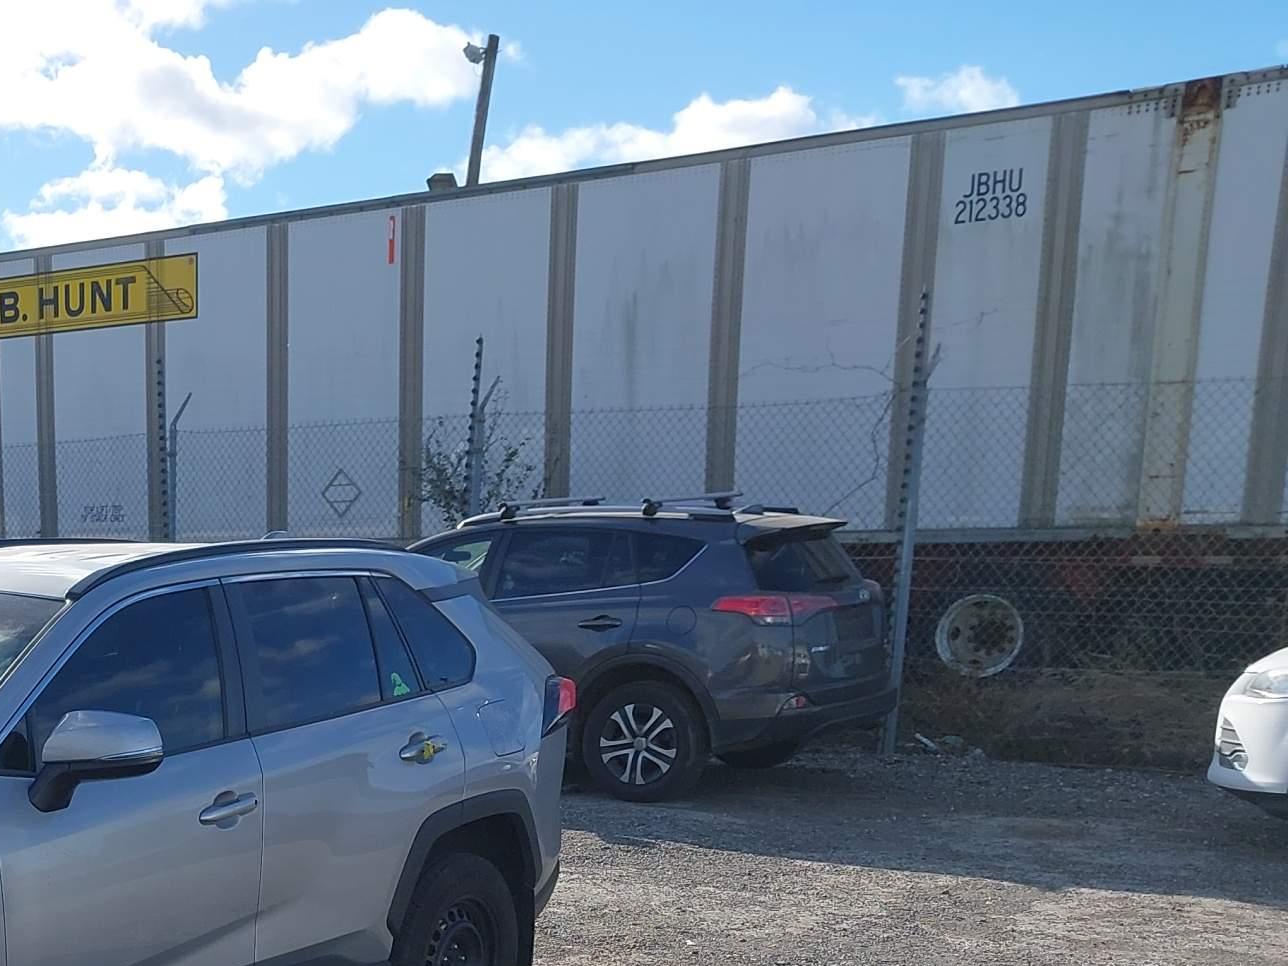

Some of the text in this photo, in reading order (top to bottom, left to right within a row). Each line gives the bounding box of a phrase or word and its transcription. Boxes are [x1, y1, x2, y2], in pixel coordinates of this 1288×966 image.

[962, 167, 1024, 198] JBHU
[954, 193, 1027, 225] 212338
[38, 275, 137, 320] HUNT
